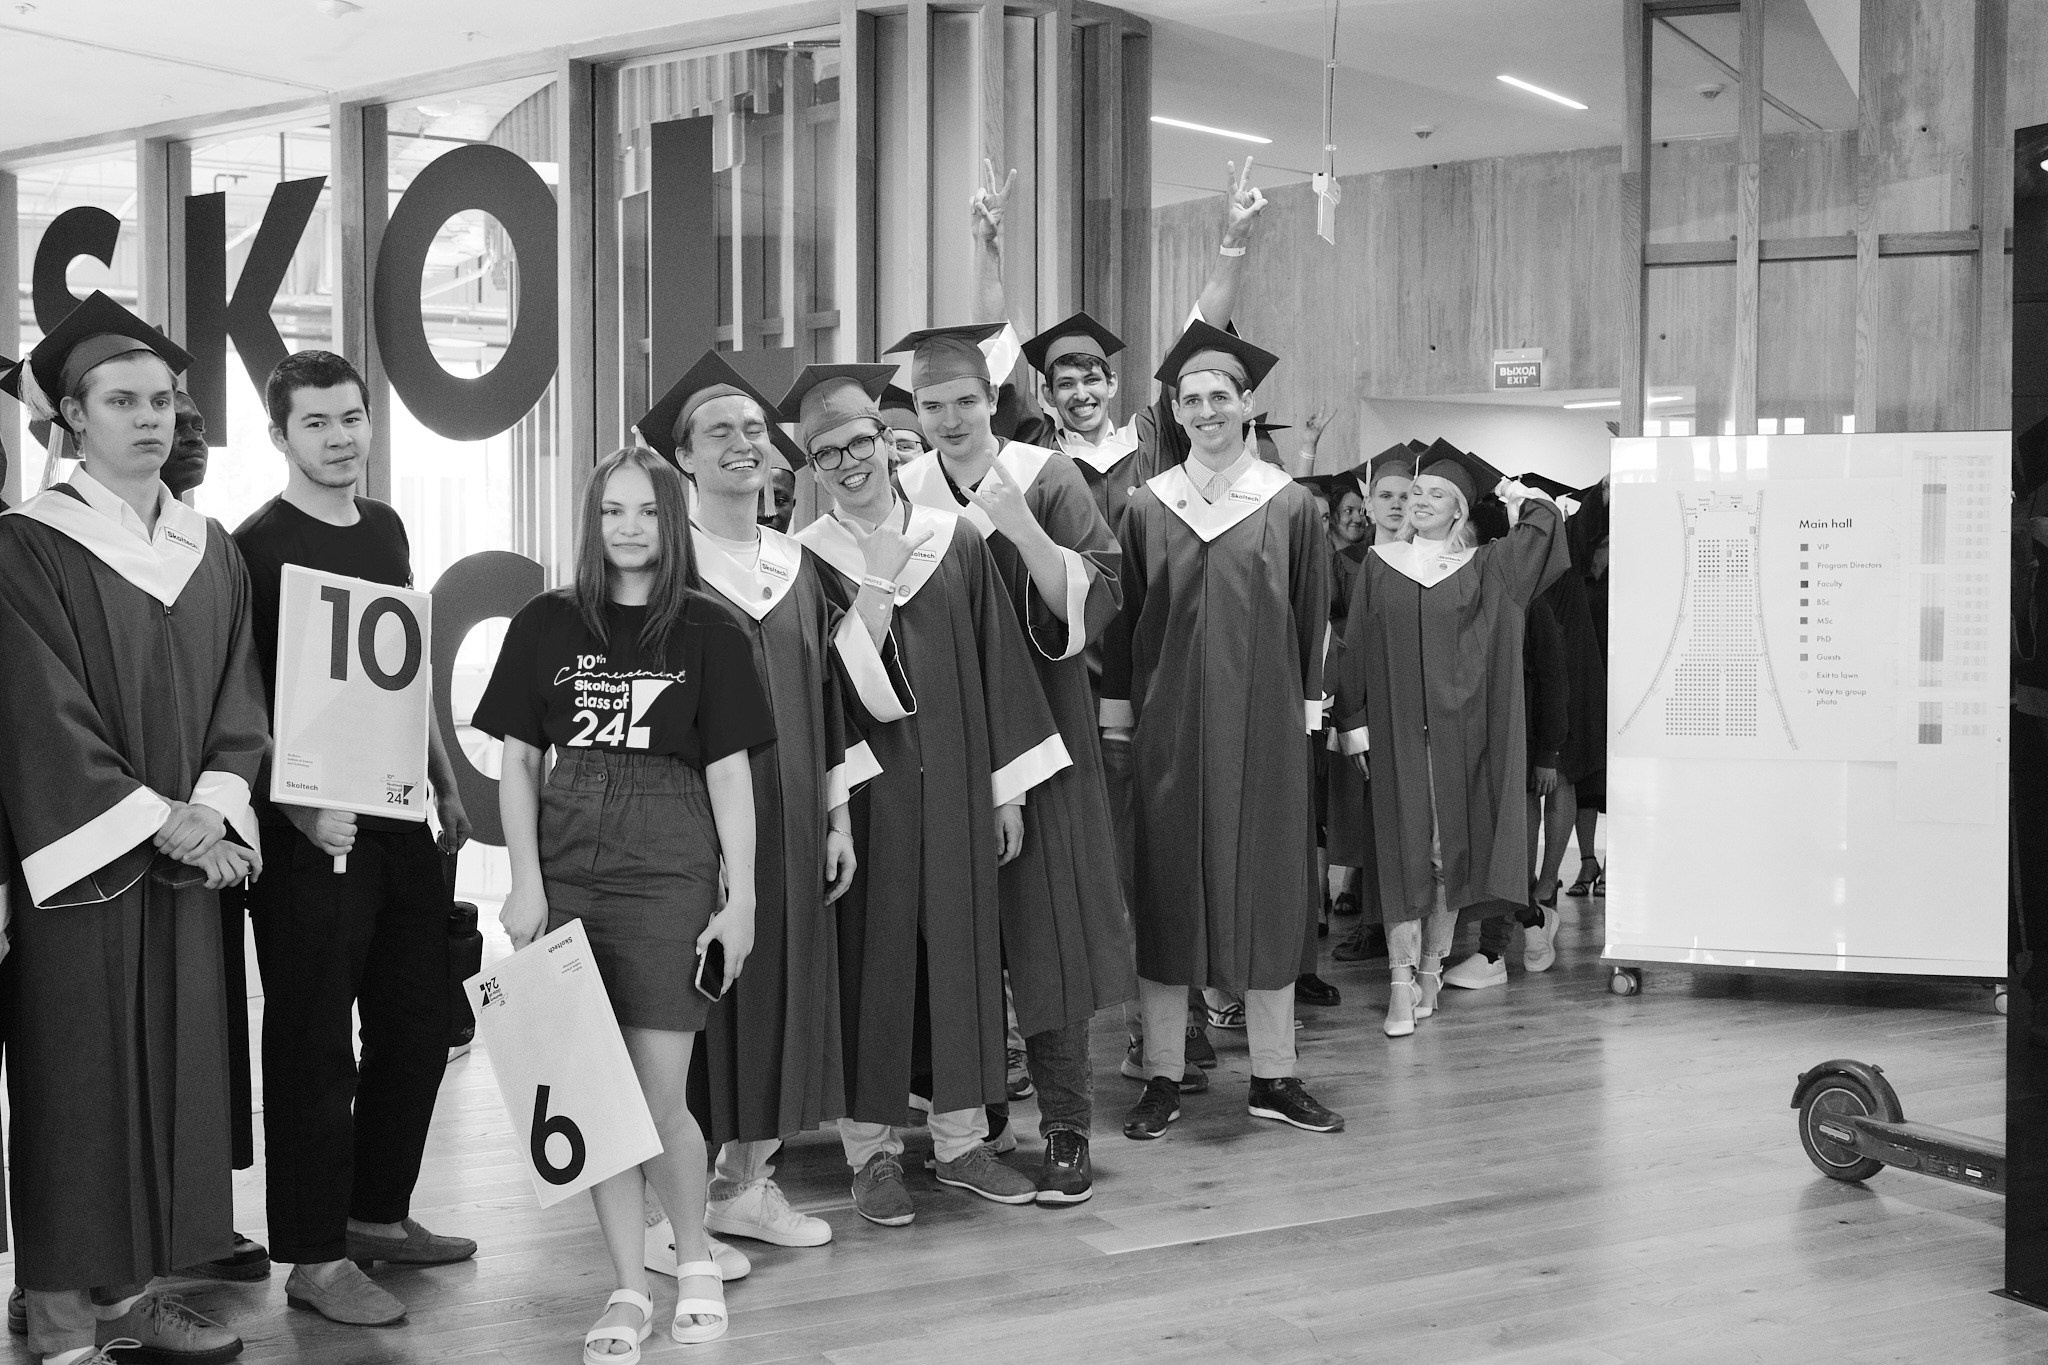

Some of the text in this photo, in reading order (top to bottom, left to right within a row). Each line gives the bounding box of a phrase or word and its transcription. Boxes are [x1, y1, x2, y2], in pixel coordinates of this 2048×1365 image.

[1499, 365, 1537, 377] ВЫХОД
[1507, 376, 1529, 385] EXIT
[1230, 492, 1259, 502] Skoltech
[1799, 518, 1853, 529] Main hall
[1816, 543, 1830, 551] VIP
[1817, 561, 1883, 570] Program Directors
[1816, 580, 1843, 588] Faculty
[1816, 598, 1831, 606] BSc
[1816, 617, 1834, 625] MSc
[320, 584, 422, 692] 10
[1816, 635, 1832, 643] PhD
[576, 653, 607, 670] 10th
[1816, 653, 1841, 661] Guests
[1816, 671, 1859, 679] Exit to lawn
[573, 679, 630, 694] Skoltech
[1816, 687, 1834, 696] Way
[1844, 688, 1867, 697] group
[574, 690, 630, 710] class of
[1816, 698, 1838, 707] photo
[286, 780, 319, 792] Skoltech
[386, 791, 402, 805] 24
[547, 936, 574, 954] Skoltech
